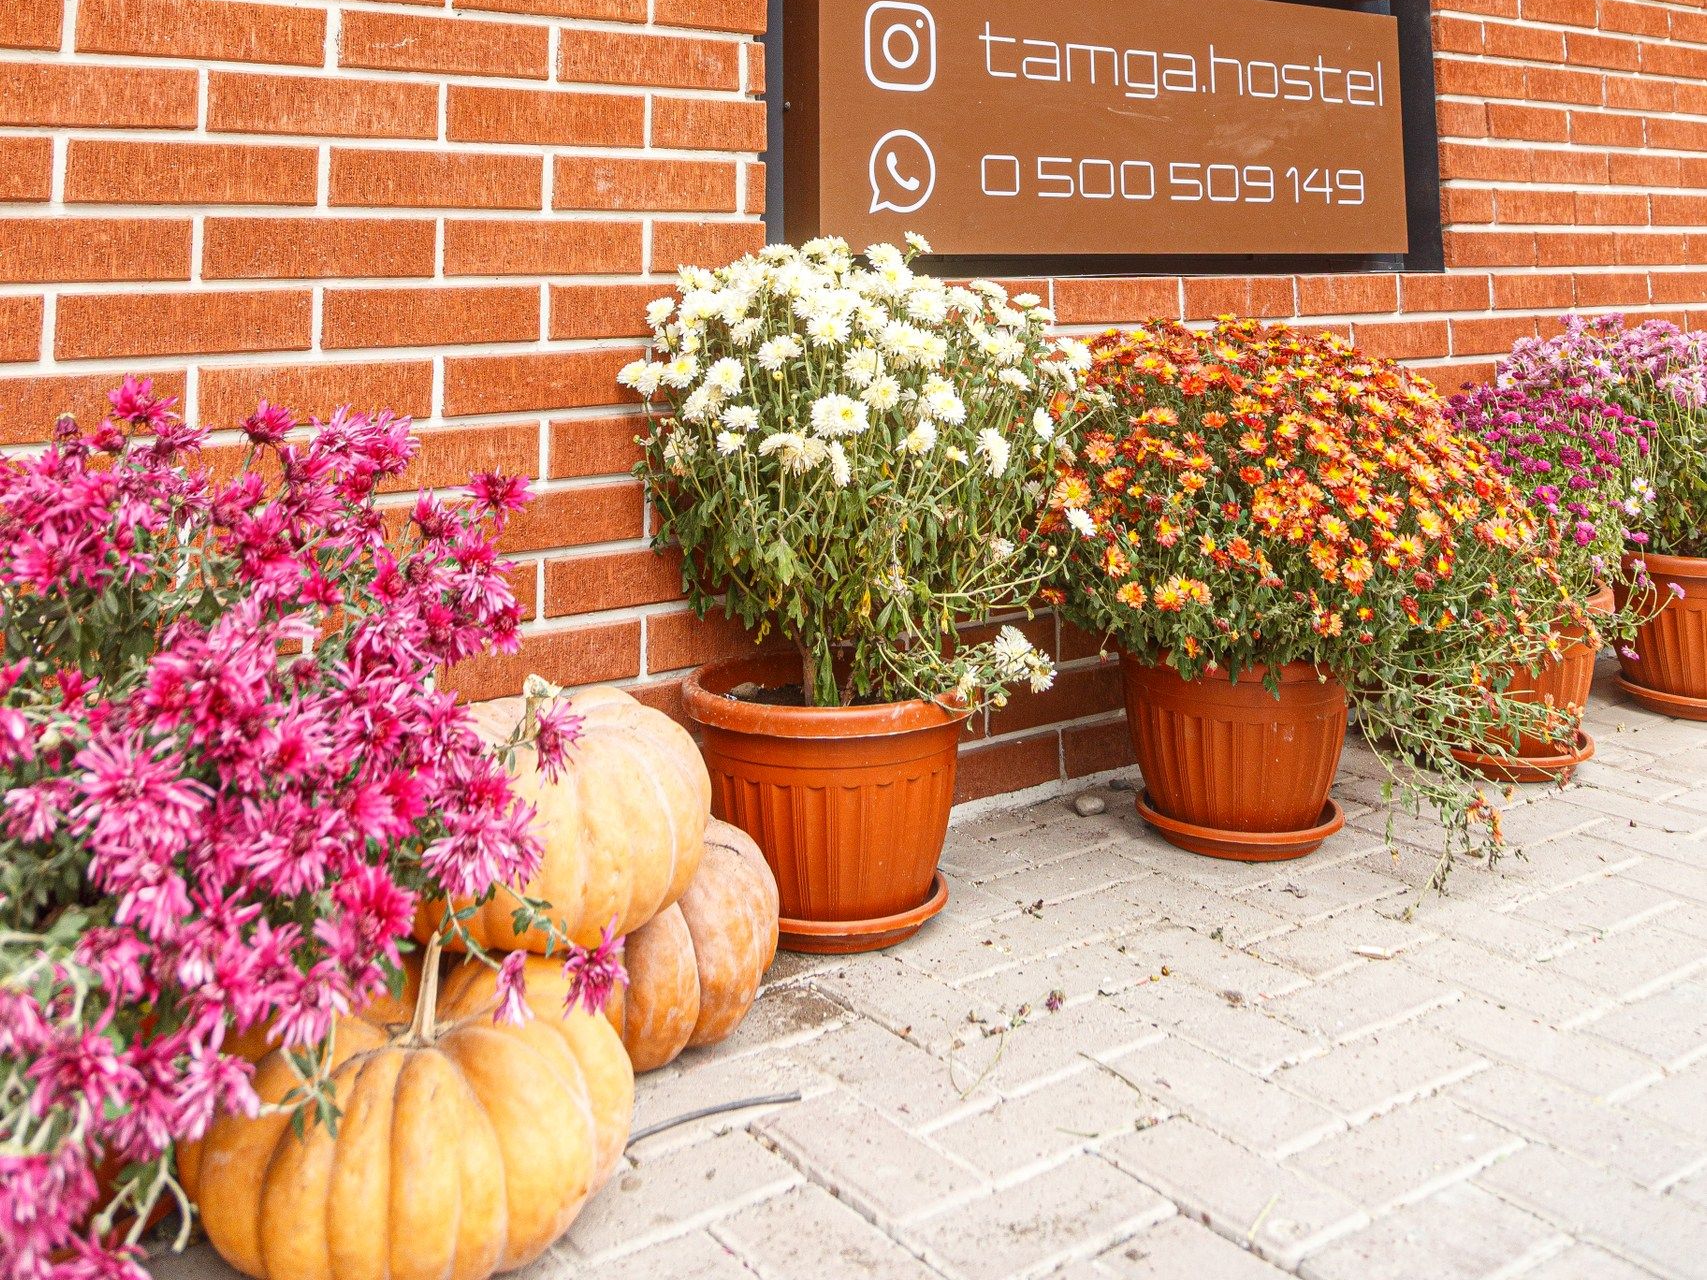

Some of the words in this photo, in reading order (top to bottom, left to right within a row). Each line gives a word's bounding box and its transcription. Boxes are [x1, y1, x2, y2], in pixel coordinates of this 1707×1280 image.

[979, 21, 1384, 107] tamga.hostel
[981, 154, 1020, 197] 0
[1037, 157, 1156, 202] 500
[1169, 163, 1275, 204] 509
[1286, 167, 1365, 206] 149
